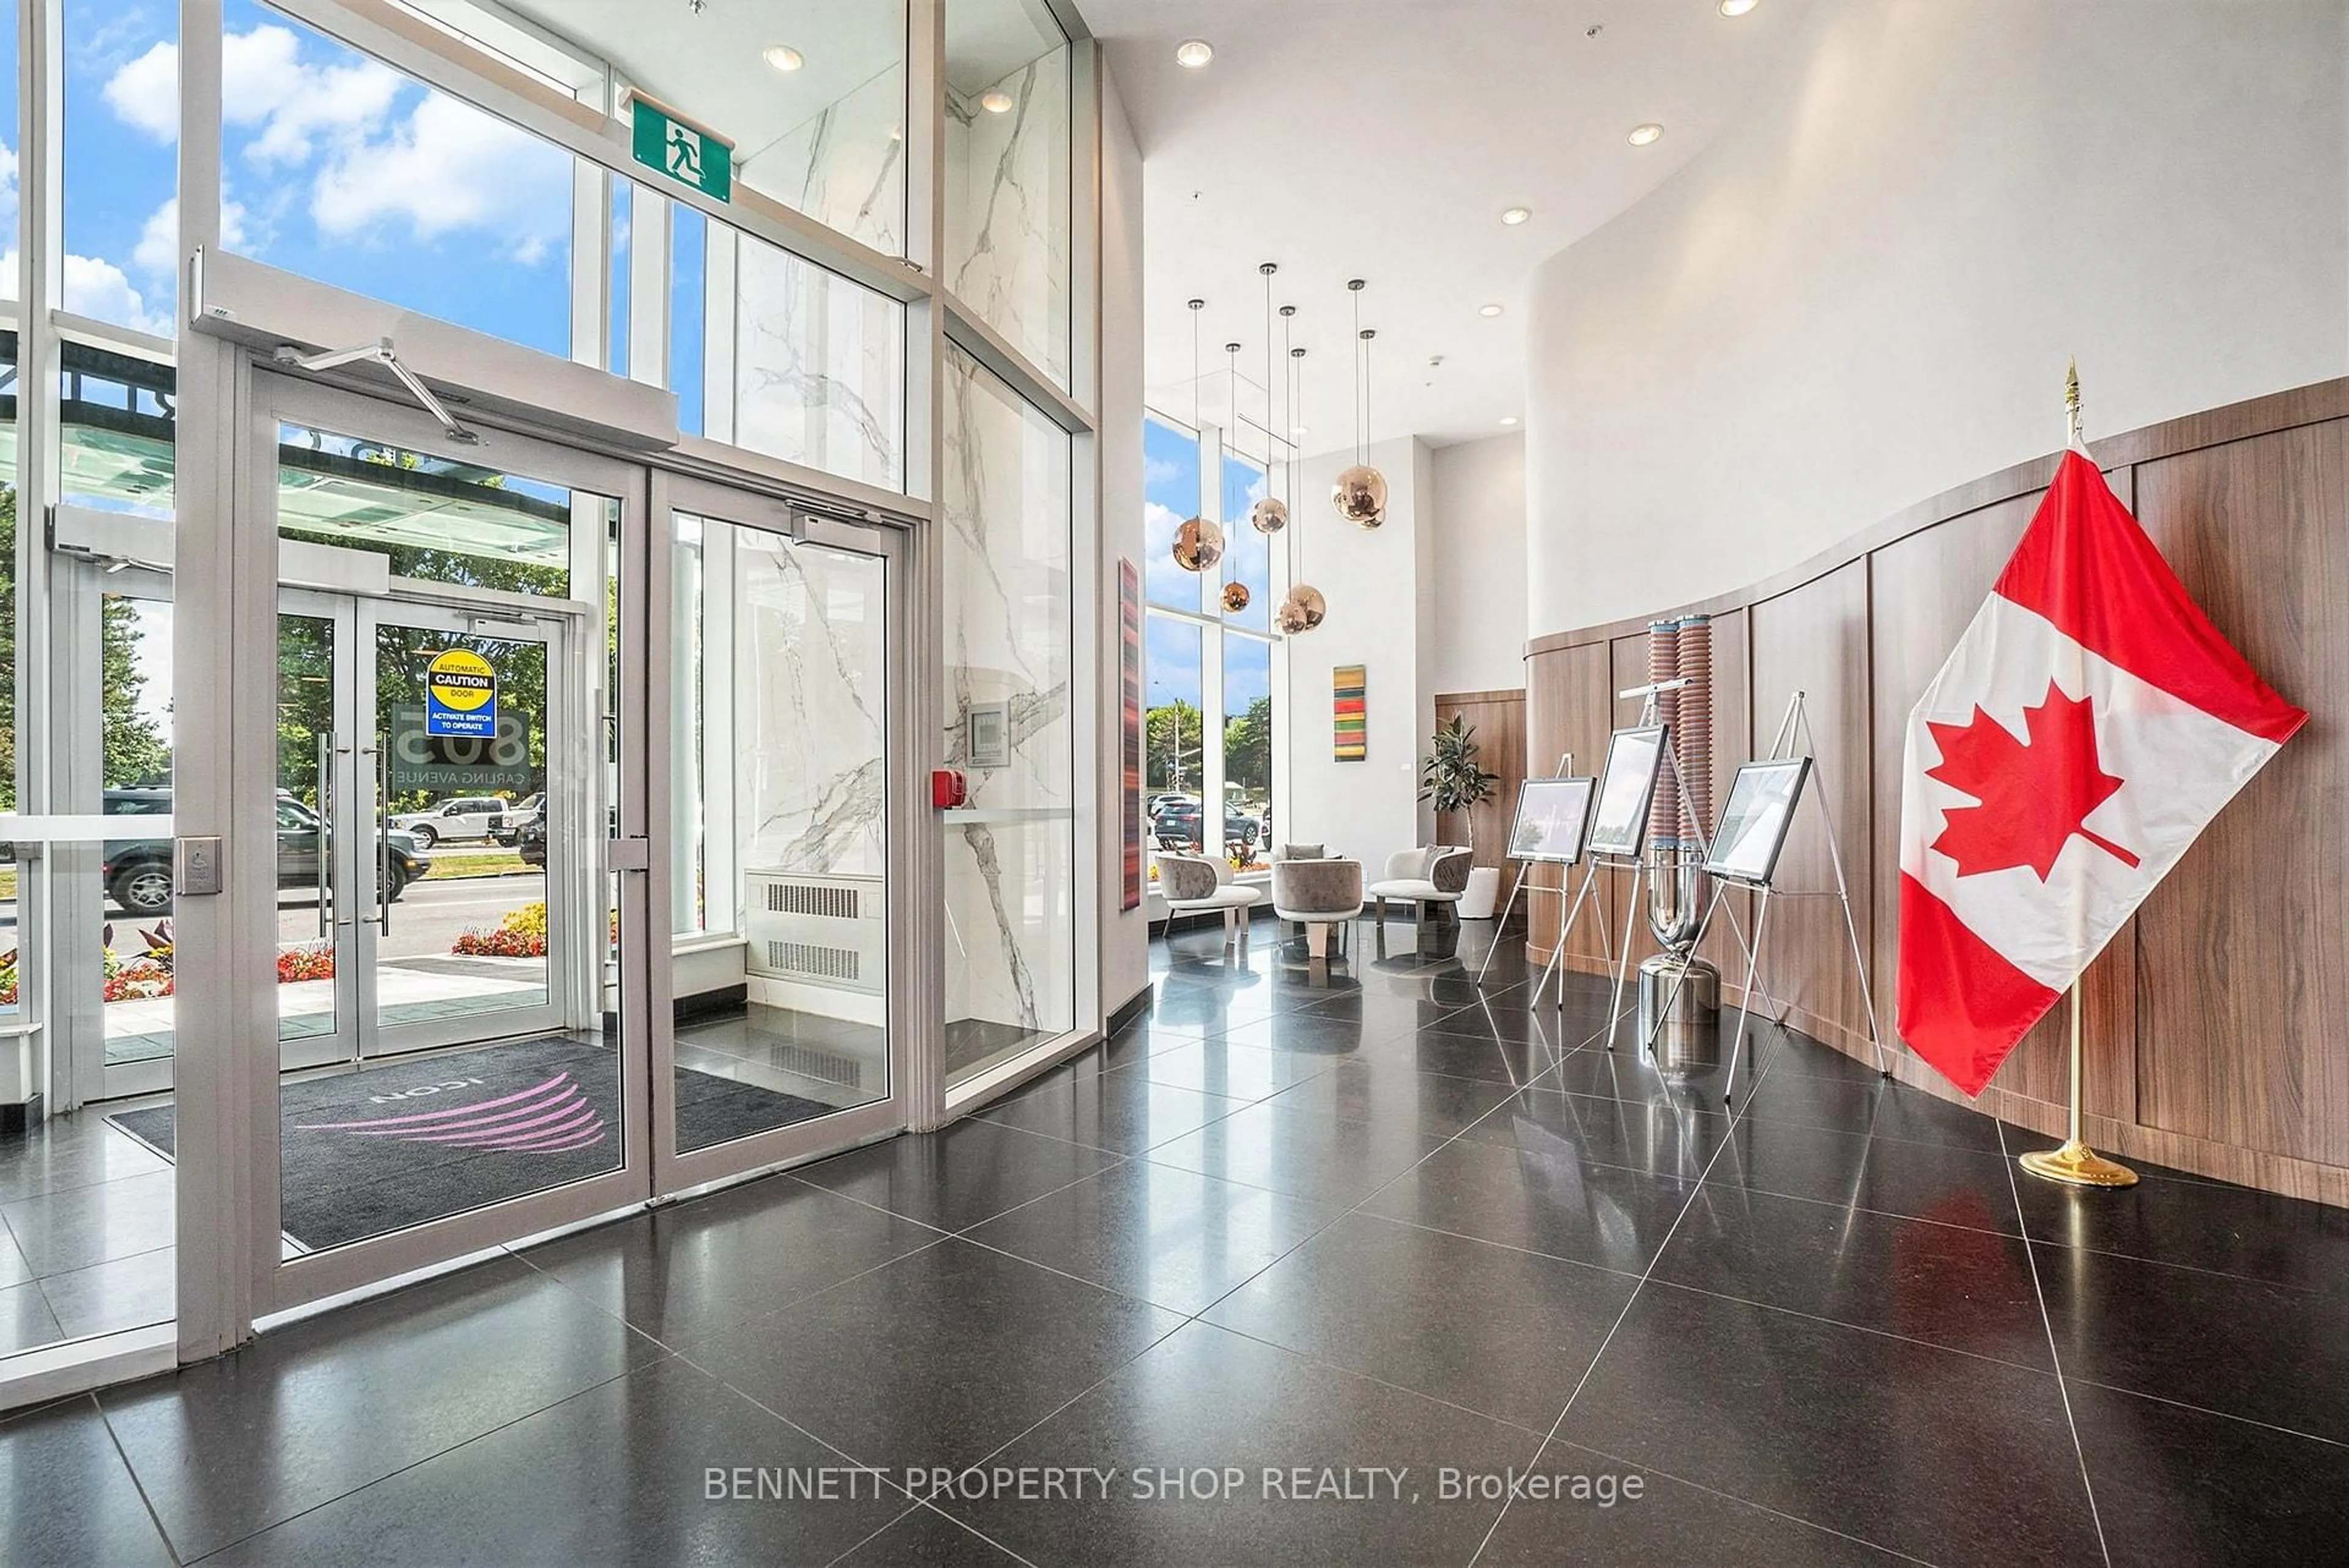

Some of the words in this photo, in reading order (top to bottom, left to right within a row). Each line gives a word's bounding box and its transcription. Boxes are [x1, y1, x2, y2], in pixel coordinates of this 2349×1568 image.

[439, 664, 486, 675] AUTOMATIC
[435, 674, 489, 687] CAUTION
[450, 689, 475, 698] DOOR
[432, 712, 464, 721] ACTIVATE
